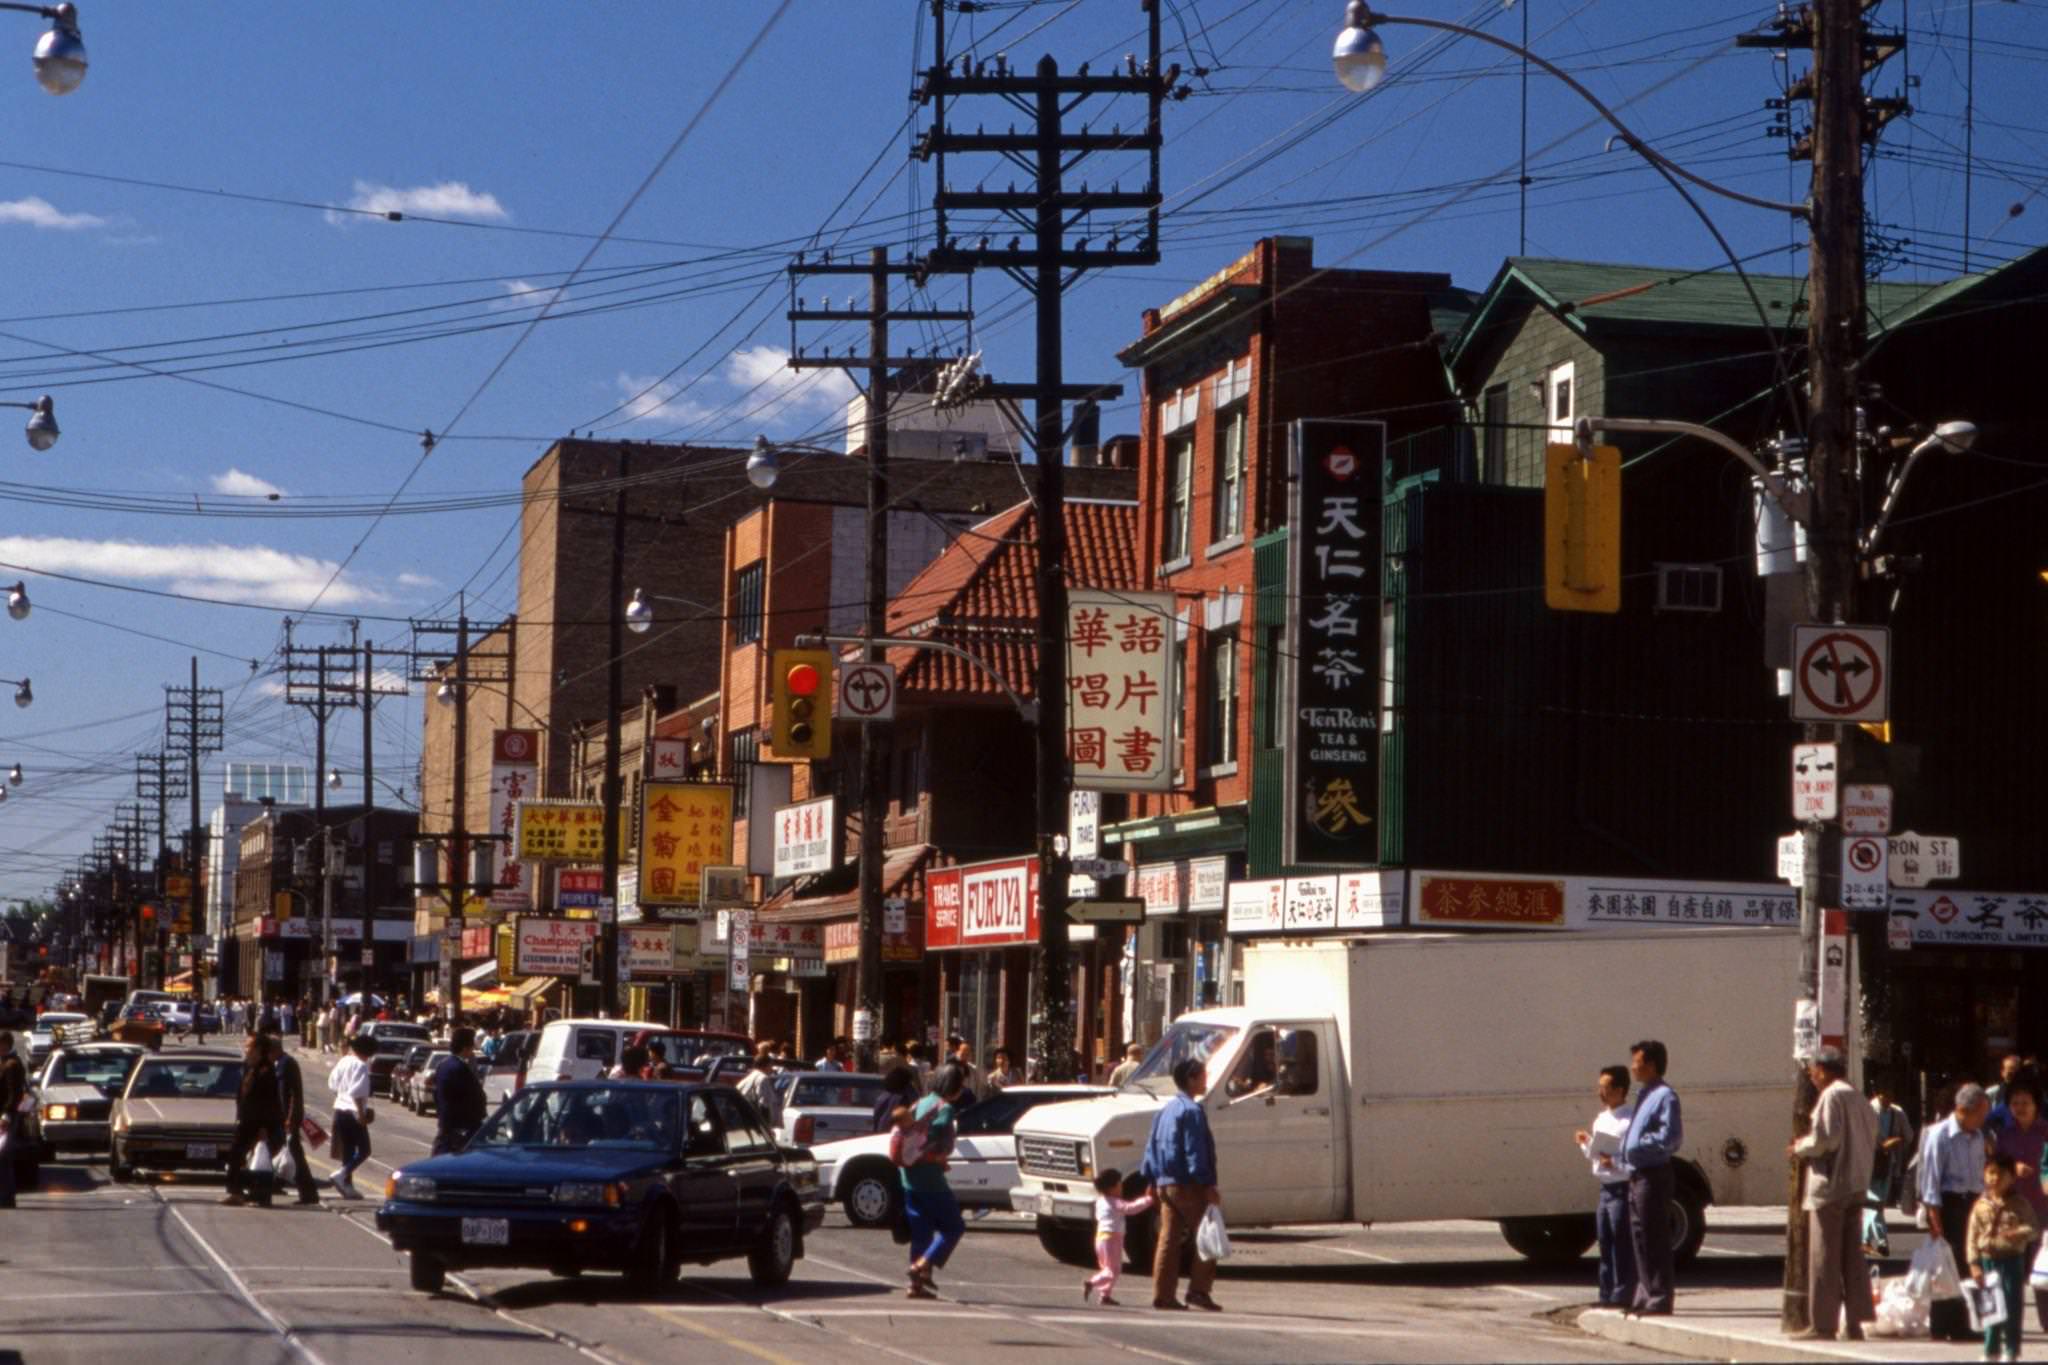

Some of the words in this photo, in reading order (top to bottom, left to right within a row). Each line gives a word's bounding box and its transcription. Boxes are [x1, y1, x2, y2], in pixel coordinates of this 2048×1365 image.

[1308, 496, 1366, 690] 天仁茗茶
[1319, 732, 1344, 745] TEA
[1348, 733, 1358, 745] &
[1310, 749, 1367, 762] GINSENG
[933, 883, 960, 907] TRAVEL
[966, 876, 1022, 930] FURUYA
[936, 909, 957, 928] SERVICE
[1743, 898, 1799, 923] 品質保
[1967, 896, 2048, 930] 茗茶
